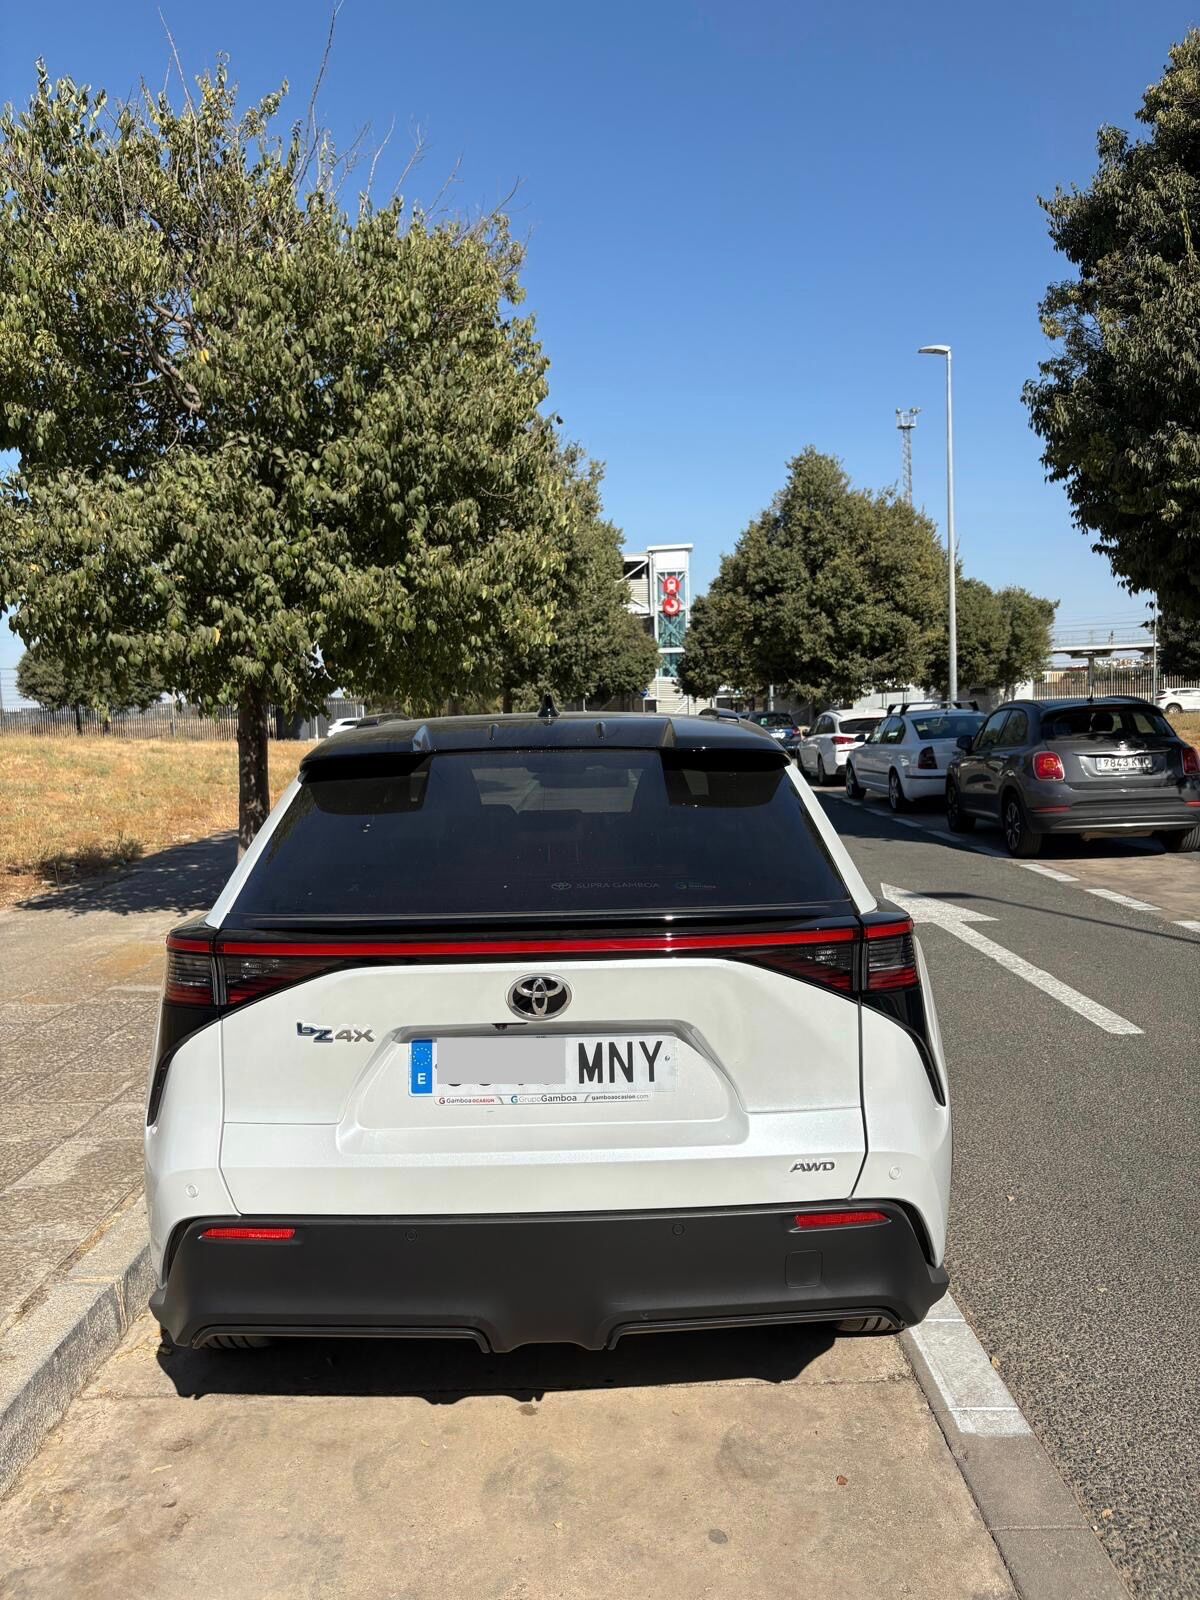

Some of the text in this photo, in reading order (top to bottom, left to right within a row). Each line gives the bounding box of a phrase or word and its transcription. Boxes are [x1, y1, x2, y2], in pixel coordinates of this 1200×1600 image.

[1104, 758, 1128, 767] 7843
[612, 881, 660, 889] GAMBOA
[578, 1040, 663, 1084] MNY
[417, 1072, 427, 1085] E
[790, 1161, 835, 1173] AWD
